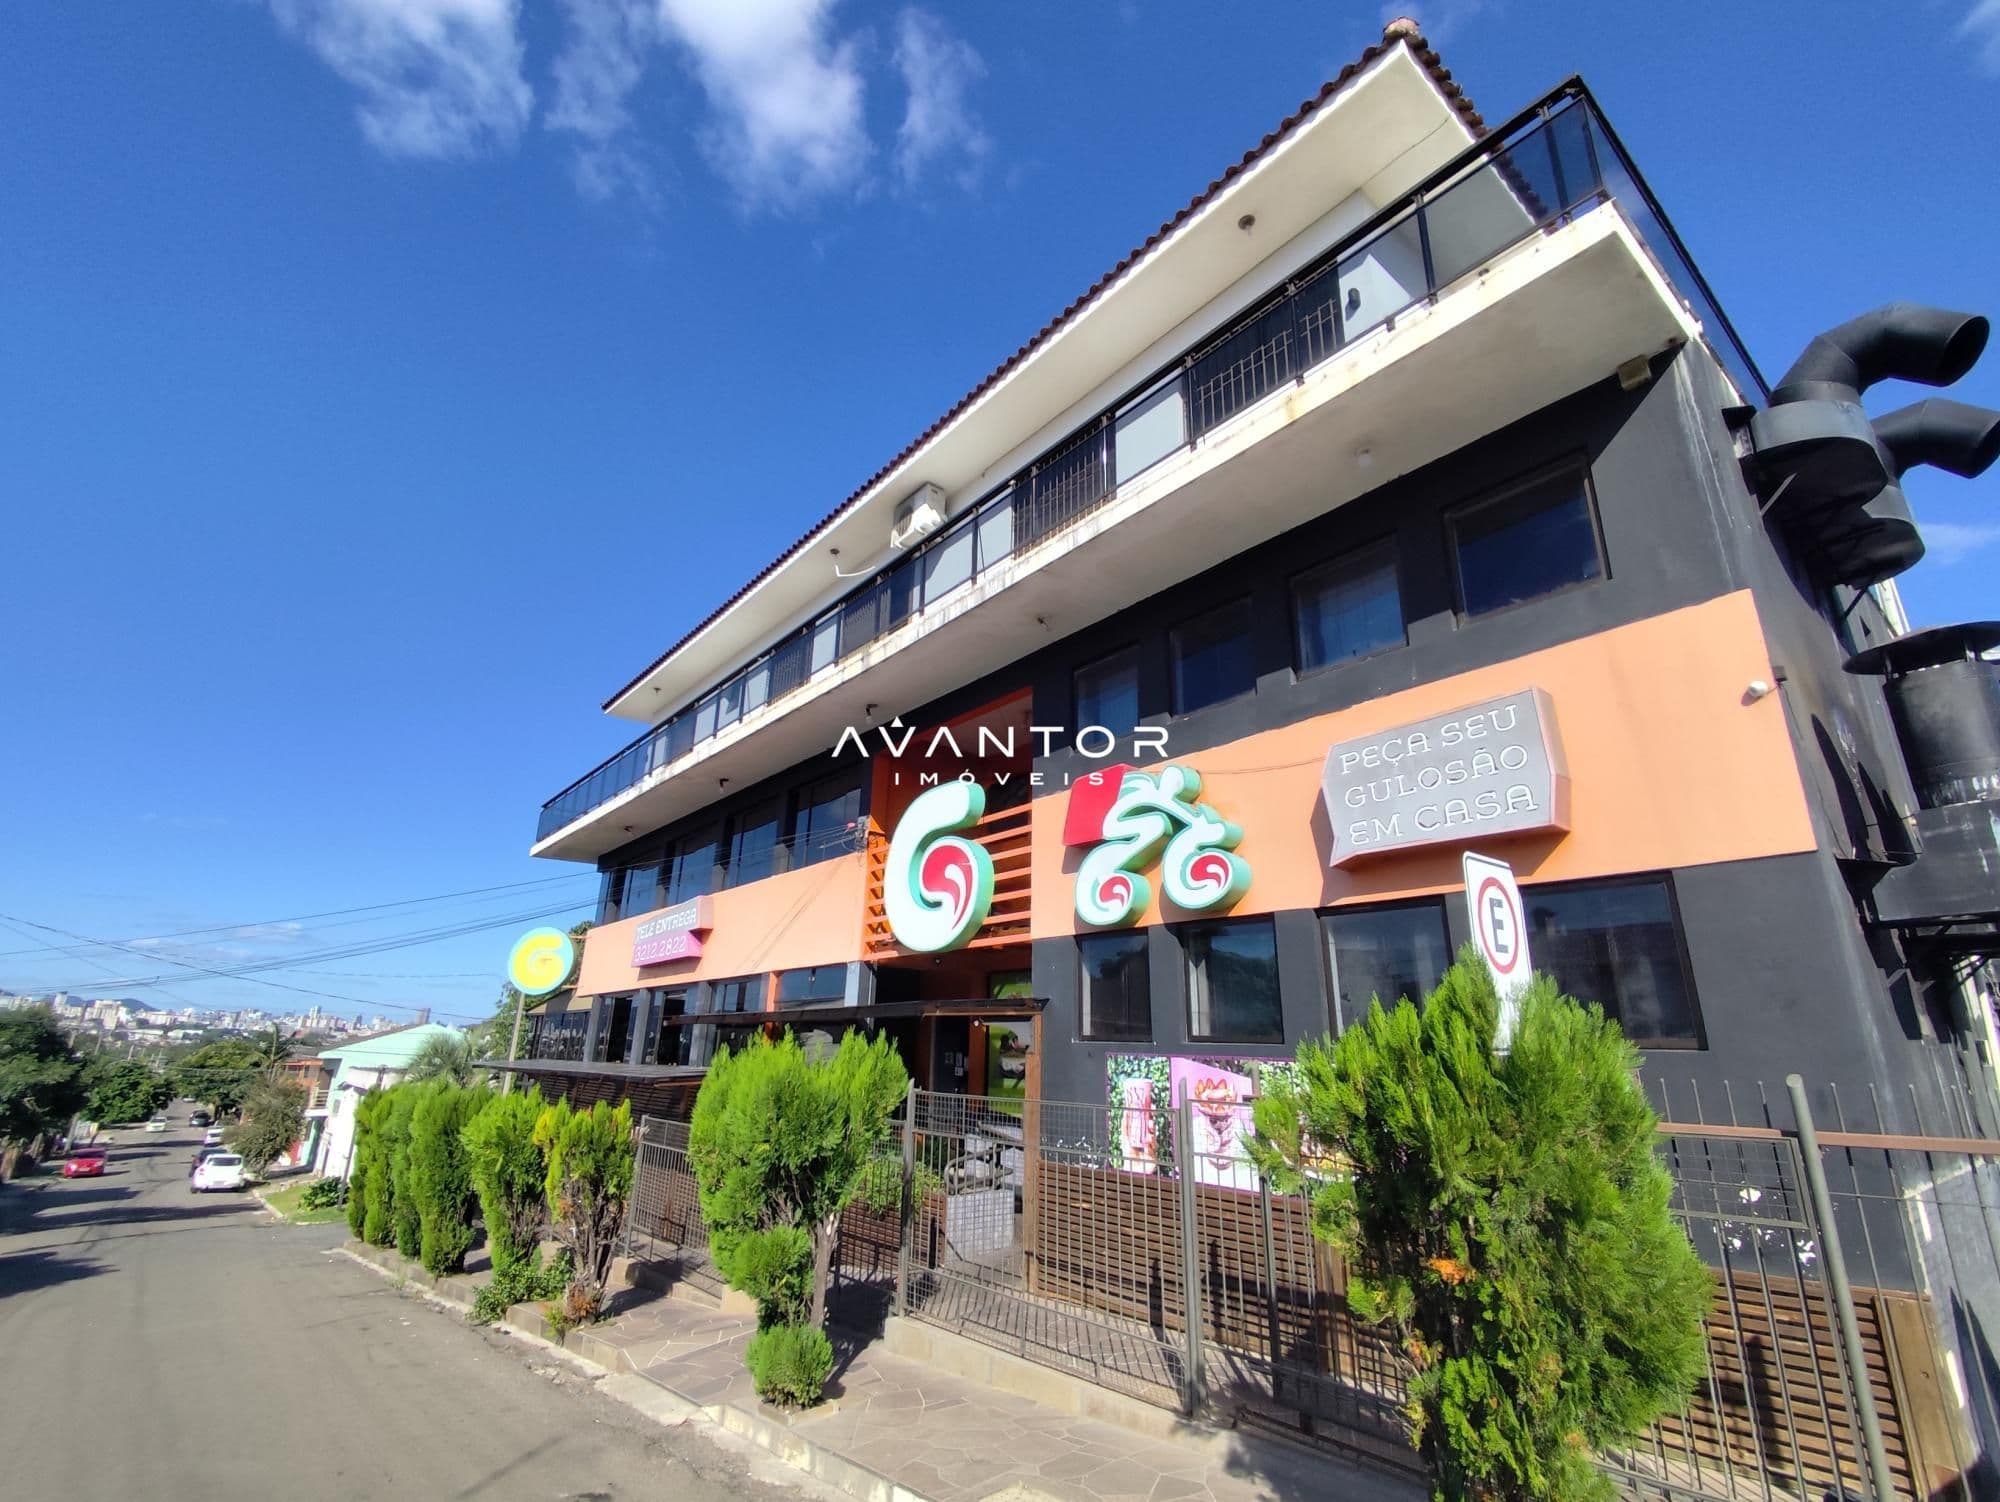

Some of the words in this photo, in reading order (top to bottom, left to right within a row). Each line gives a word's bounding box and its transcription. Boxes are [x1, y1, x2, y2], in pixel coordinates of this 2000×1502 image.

[1339, 732, 1433, 775] PEÇA
[1441, 704, 1518, 747] SEU
[1344, 745, 1529, 808] GULOSÃO
[1349, 813, 1403, 846] EM
[1414, 784, 1539, 832] CASA
[656, 908, 697, 934] ENTREGA
[1488, 897, 1509, 954] E
